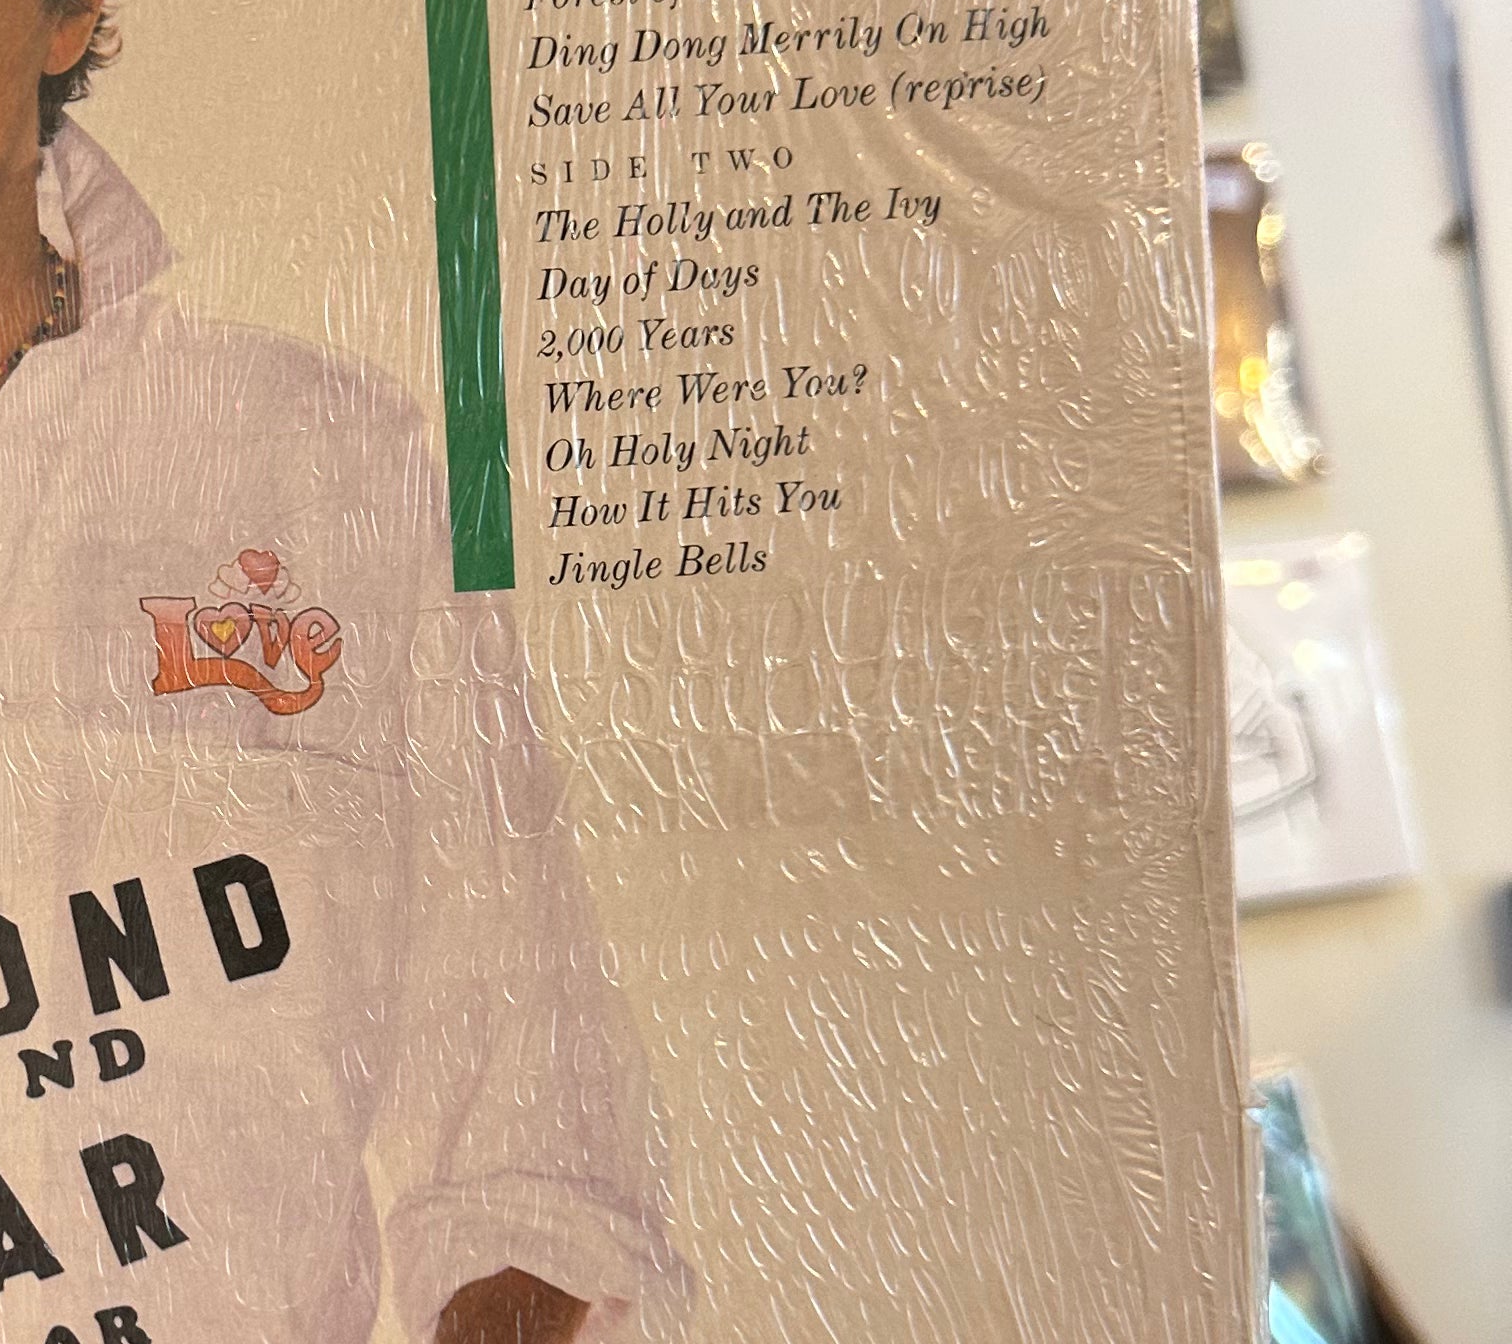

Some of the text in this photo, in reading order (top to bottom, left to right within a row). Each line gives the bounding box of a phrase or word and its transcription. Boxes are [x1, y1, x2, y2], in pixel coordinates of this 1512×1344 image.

[527, 6, 1049, 74] Ding Dong Merrily On High
[529, 64, 1045, 127] Save All Your Love (reprise)
[531, 146, 793, 185] SIDE TWO
[535, 187, 942, 243] The Holly and The Ivy
[537, 258, 759, 306] Day of Days
[537, 318, 735, 362] 2,000 Years
[545, 364, 868, 414] Where Were You?
[545, 425, 811, 472] Oh Holy Night
[548, 480, 843, 528] How It Hits You
[548, 541, 768, 591] Jingle Bells
